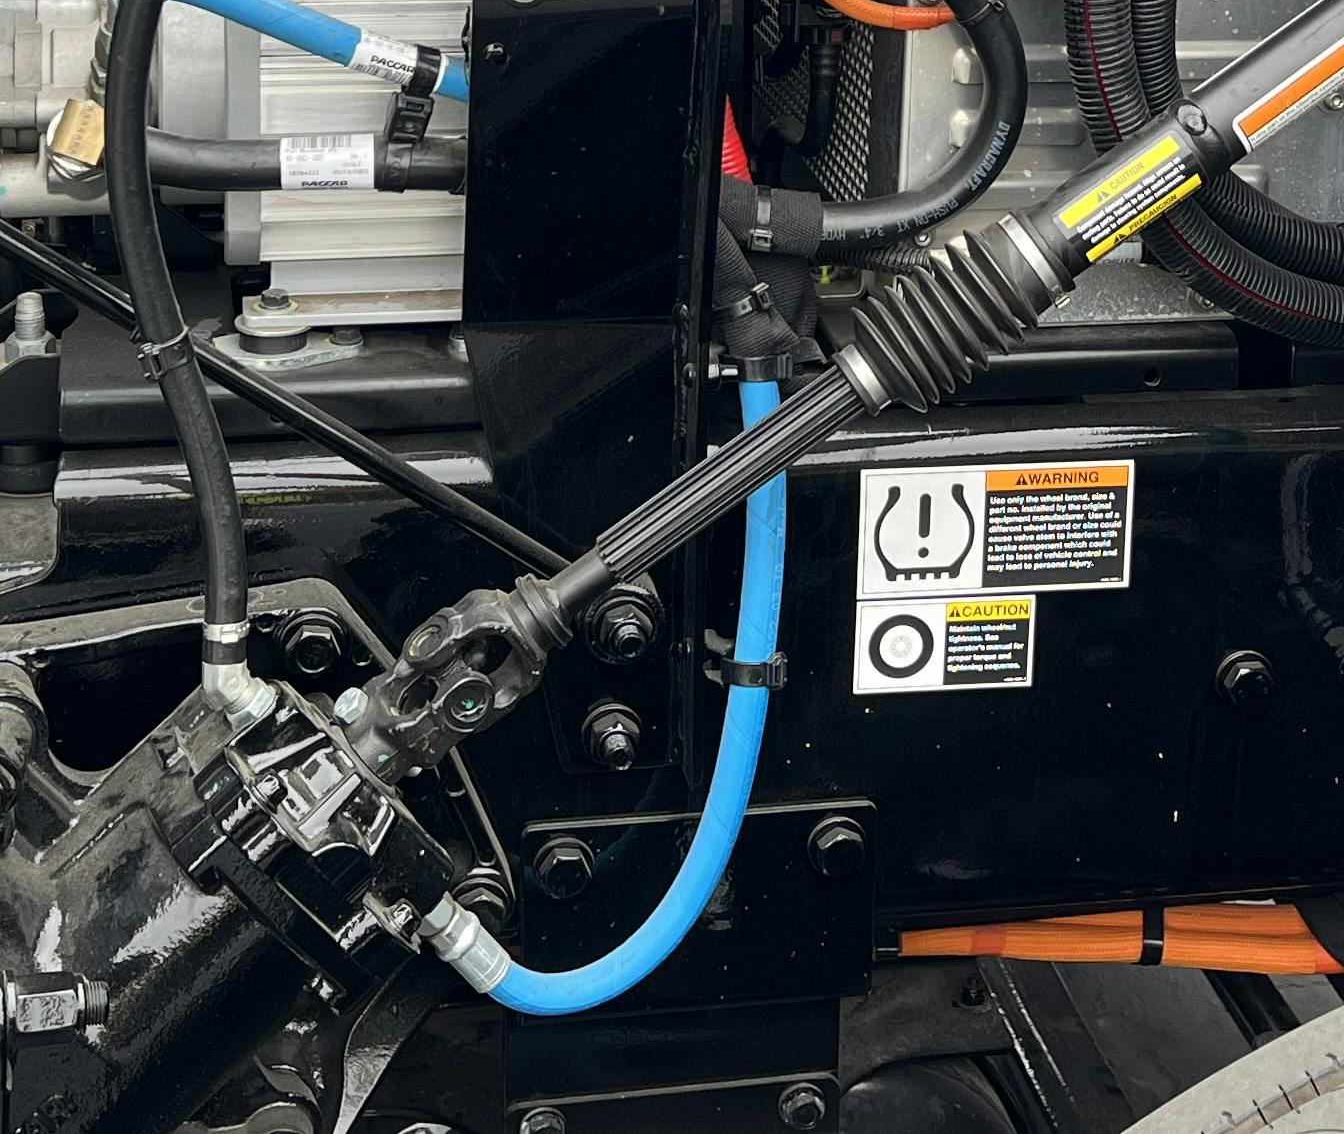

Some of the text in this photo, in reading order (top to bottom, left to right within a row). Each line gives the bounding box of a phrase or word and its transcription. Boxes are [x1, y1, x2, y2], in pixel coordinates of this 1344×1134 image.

[1110, 162, 1144, 190] CAUTION
[1028, 471, 1099, 485] WARNING
[962, 604, 1029, 617] CAUTION
